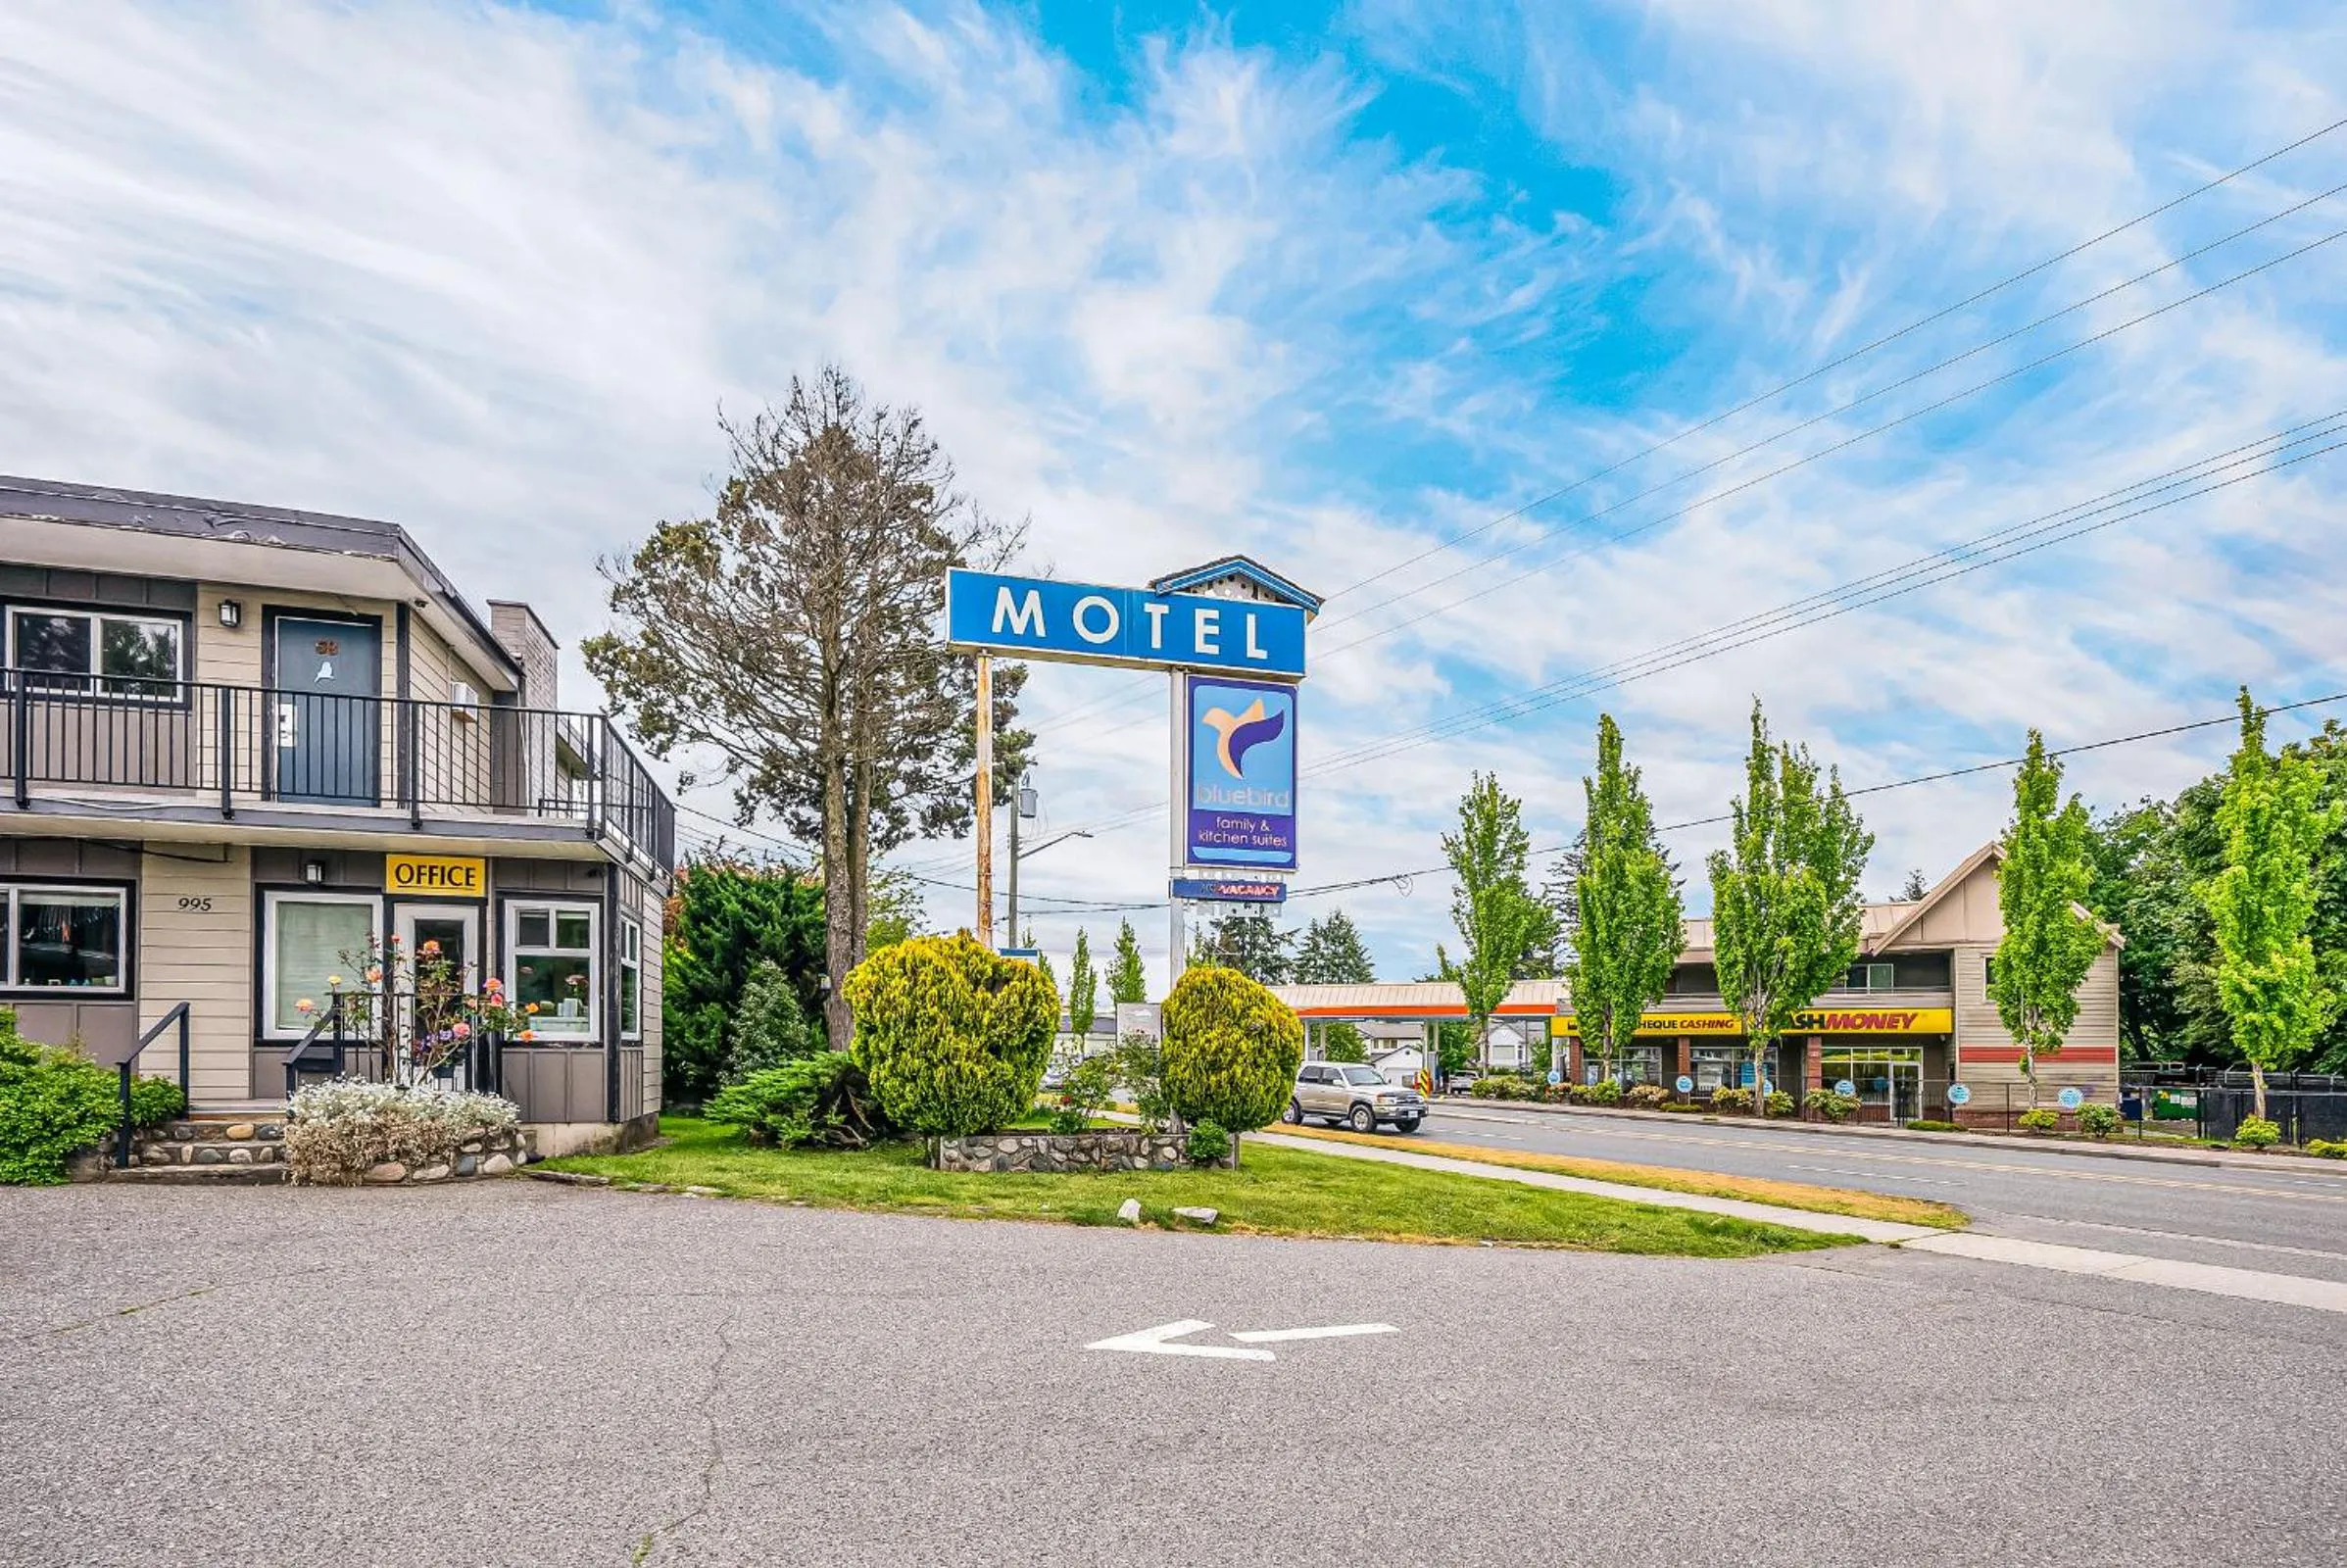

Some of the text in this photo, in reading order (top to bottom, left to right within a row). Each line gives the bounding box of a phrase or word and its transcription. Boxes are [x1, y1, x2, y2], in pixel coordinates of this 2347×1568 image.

[992, 586, 1268, 660] MOTEL
[1198, 784, 1290, 808] bluebird
[1216, 816, 1270, 833] family &
[1198, 830, 1287, 848] kitchen suites
[395, 863, 476, 887] OFFICE
[1218, 885, 1279, 897] VACANCY
[178, 897, 212, 911] 995
[1638, 1019, 1735, 1029] HEQUE CASHING
